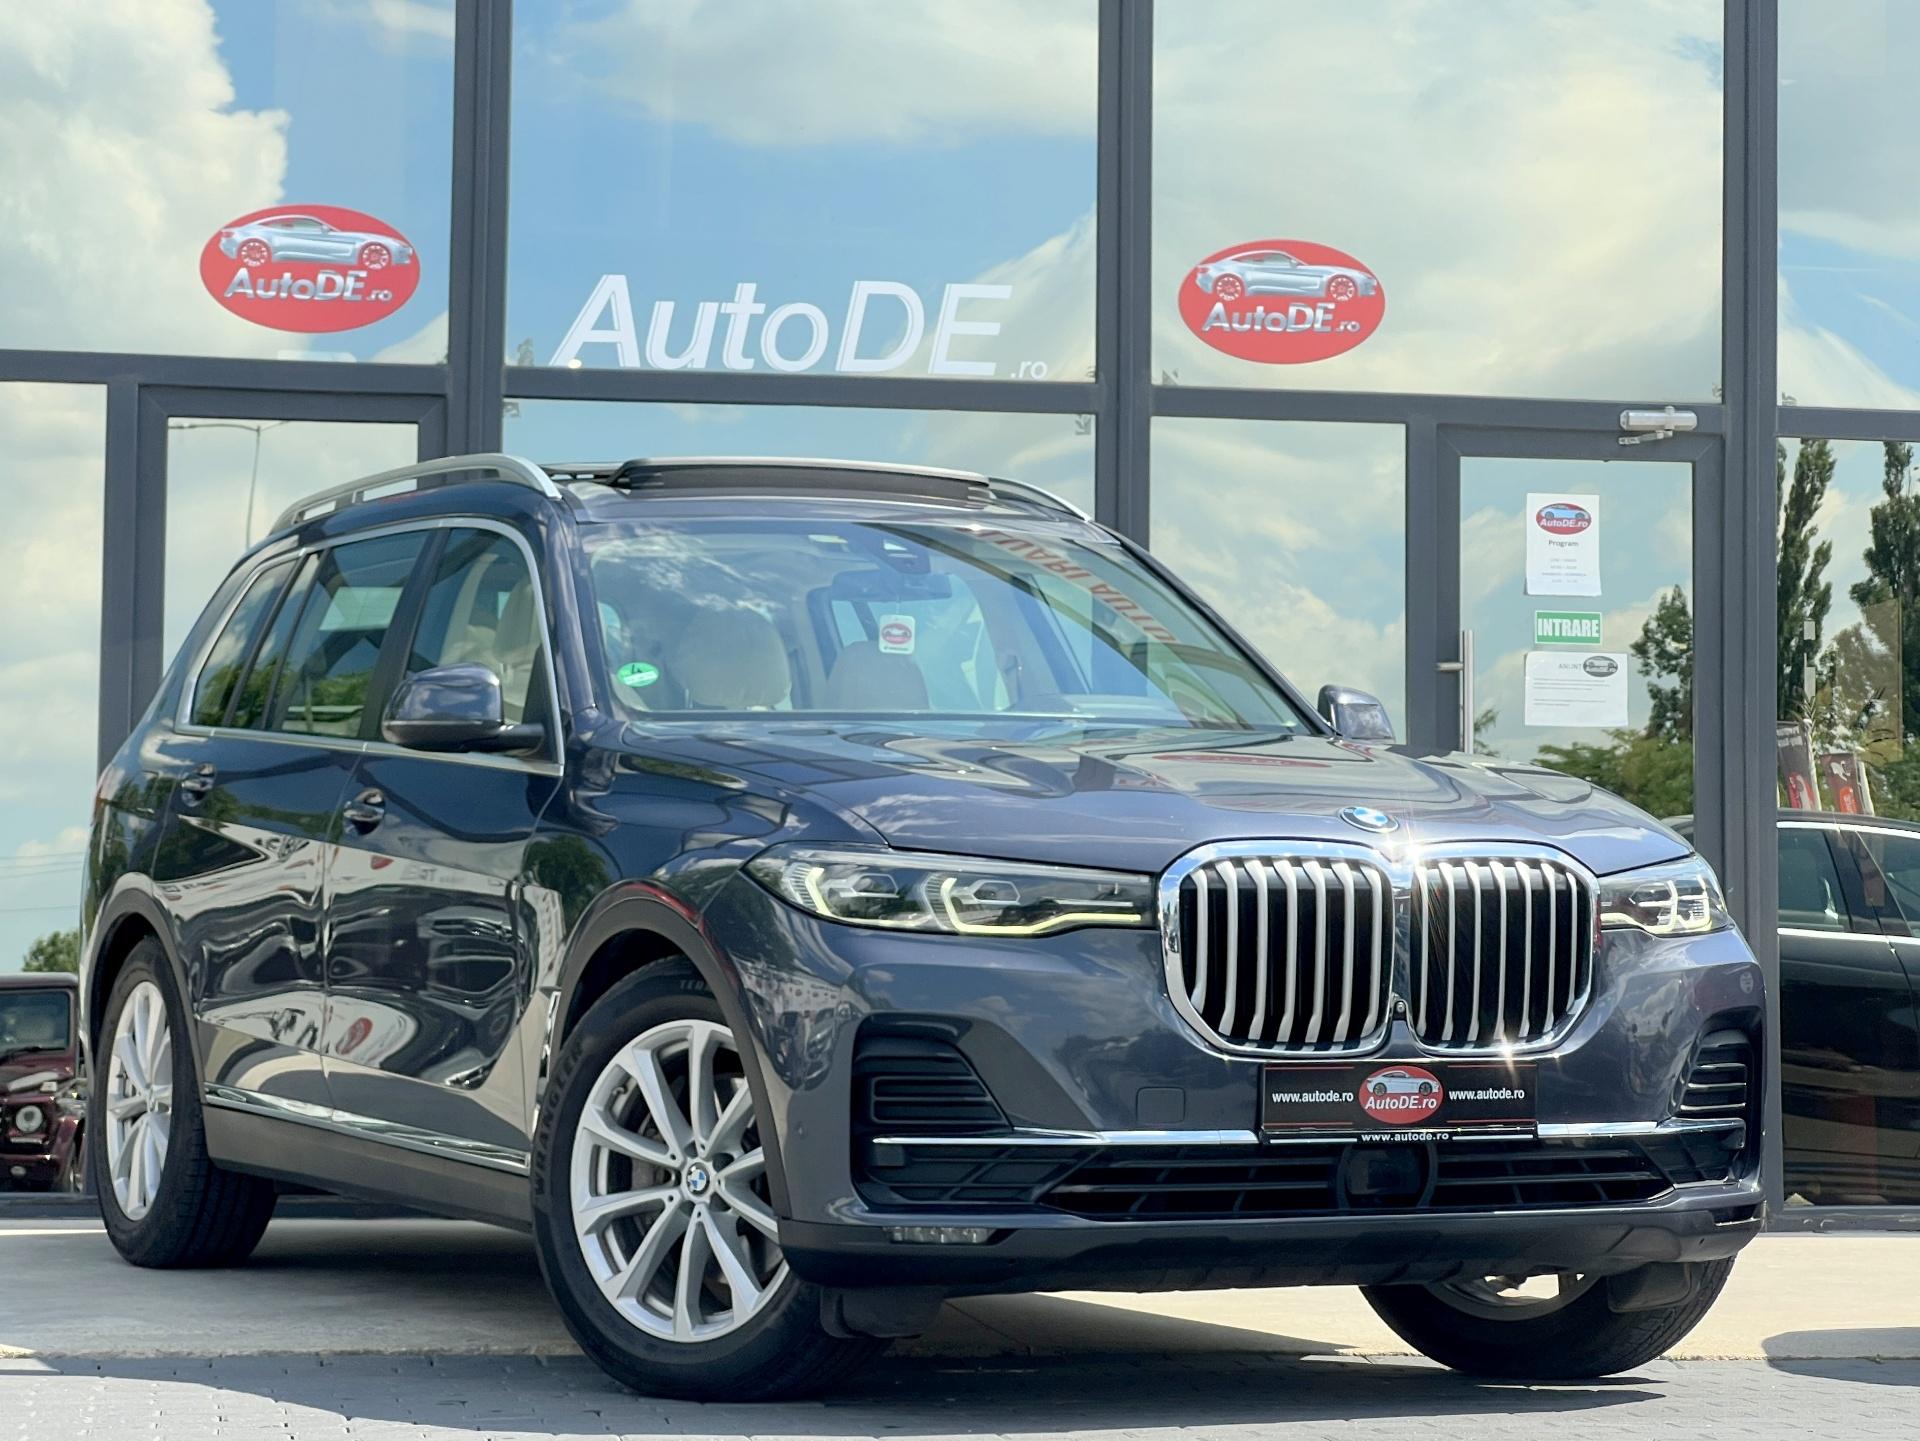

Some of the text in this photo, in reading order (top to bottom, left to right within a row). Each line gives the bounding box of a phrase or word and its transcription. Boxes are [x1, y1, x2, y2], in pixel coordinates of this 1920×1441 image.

[1537, 618, 1600, 637] INTRARE
[1272, 1089, 1354, 1103] www.autode.ro
[1448, 1088, 1525, 1101] www.autode.ro
[1364, 1095, 1437, 1110] AutoDE.ro
[1361, 1131, 1450, 1142] www.autode.ro
